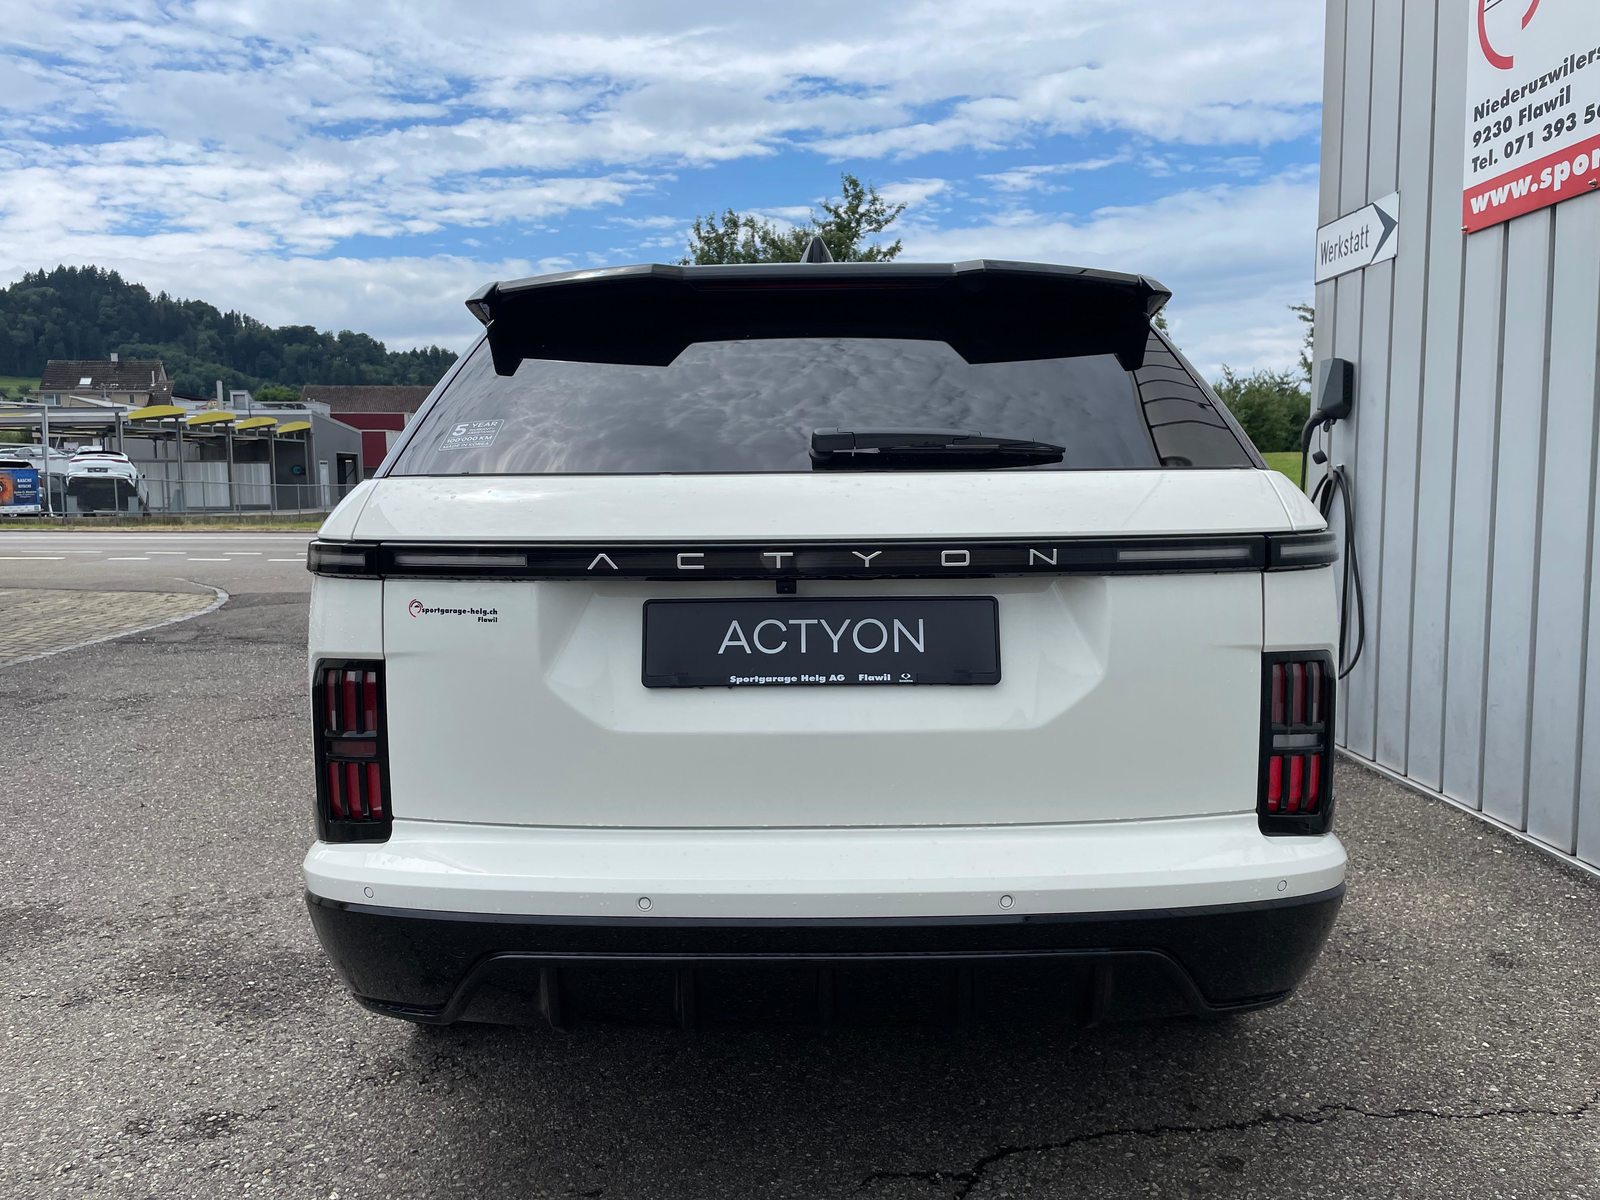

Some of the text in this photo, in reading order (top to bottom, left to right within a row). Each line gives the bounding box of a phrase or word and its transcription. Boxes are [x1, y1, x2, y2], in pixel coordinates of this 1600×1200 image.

[1472, 84, 1571, 148] 9230 Flawil
[1472, 149, 1498, 173] Tel.
[1504, 131, 1534, 158] 071
[1542, 112, 1577, 142] 393
[1320, 223, 1370, 266] Werkstatt
[452, 423, 470, 436] 5
[586, 548, 1058, 570] ACTYON
[717, 618, 925, 655] ACTYON
[729, 675, 798, 685] Sportgarage
[800, 674, 826, 683] Helg
[828, 674, 846, 682] AG
[858, 673, 891, 681] Flawil
